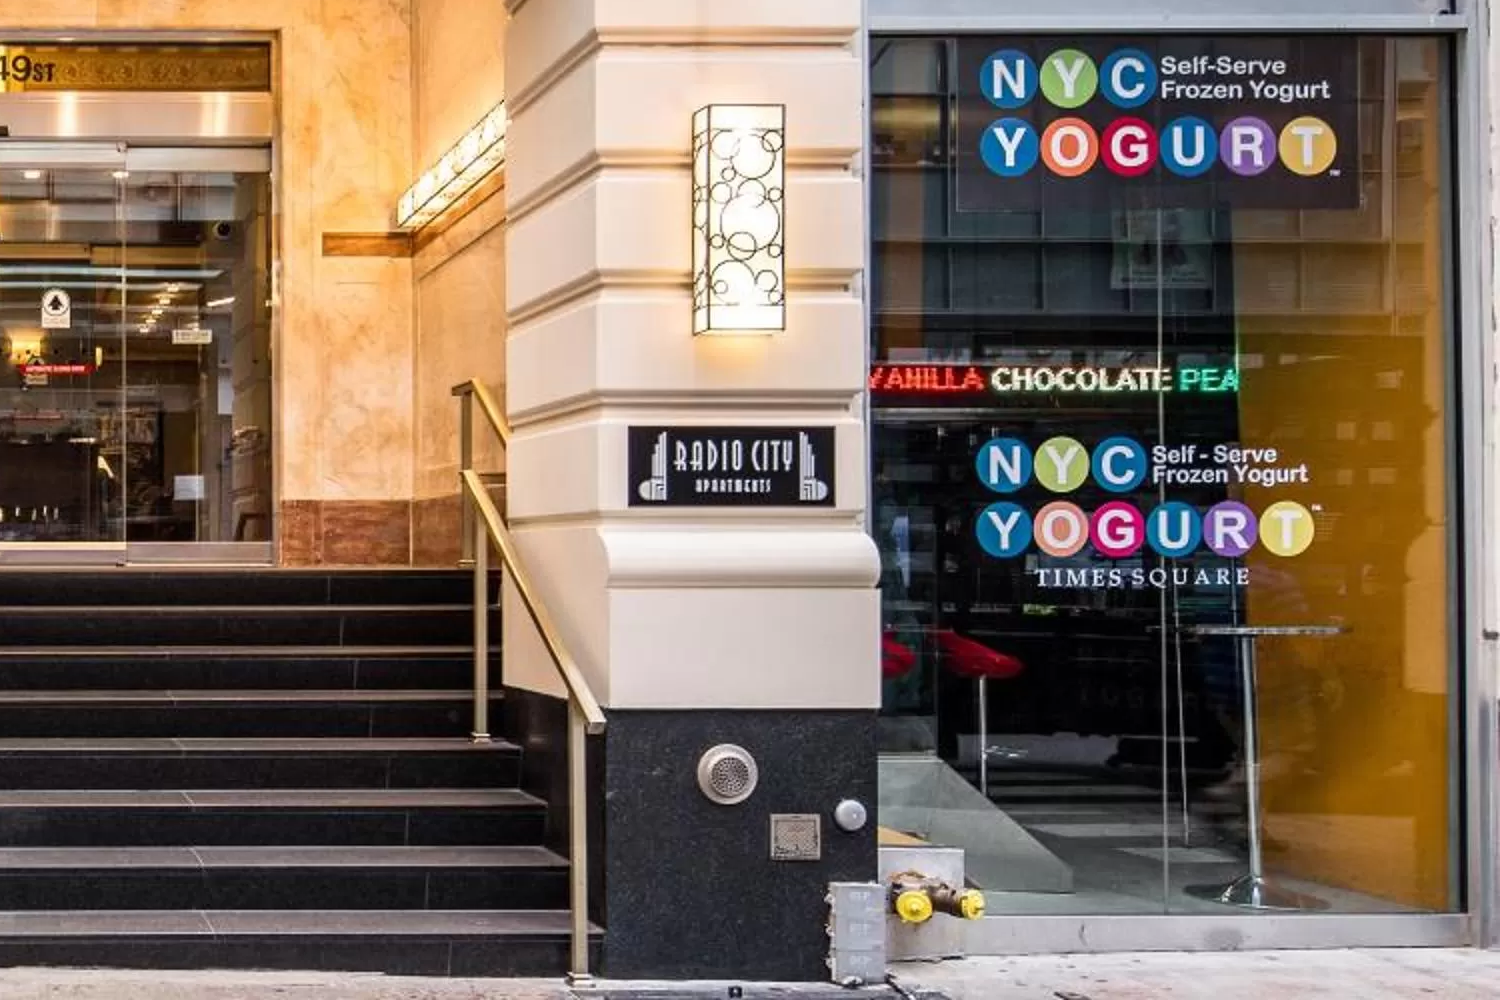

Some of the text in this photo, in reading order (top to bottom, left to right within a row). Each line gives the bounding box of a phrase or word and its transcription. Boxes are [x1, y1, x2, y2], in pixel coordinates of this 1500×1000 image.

[1160, 55, 1287, 76] Self-Serve
[990, 55, 1146, 101] NYC
[1160, 80, 1331, 103] Frozen Yogurt
[991, 124, 1327, 169] YOGURT
[991, 367, 1173, 391] CHOCOLATE
[673, 438, 794, 472] RADIO CITY
[986, 444, 1138, 486] NYC
[1152, 445, 1195, 464] Self
[1213, 446, 1278, 464] Serve
[1152, 464, 1309, 487] Frozen Yogurt
[986, 509, 1308, 552] YOGURT
[1035, 568, 1251, 589] TIMES SQUARE
